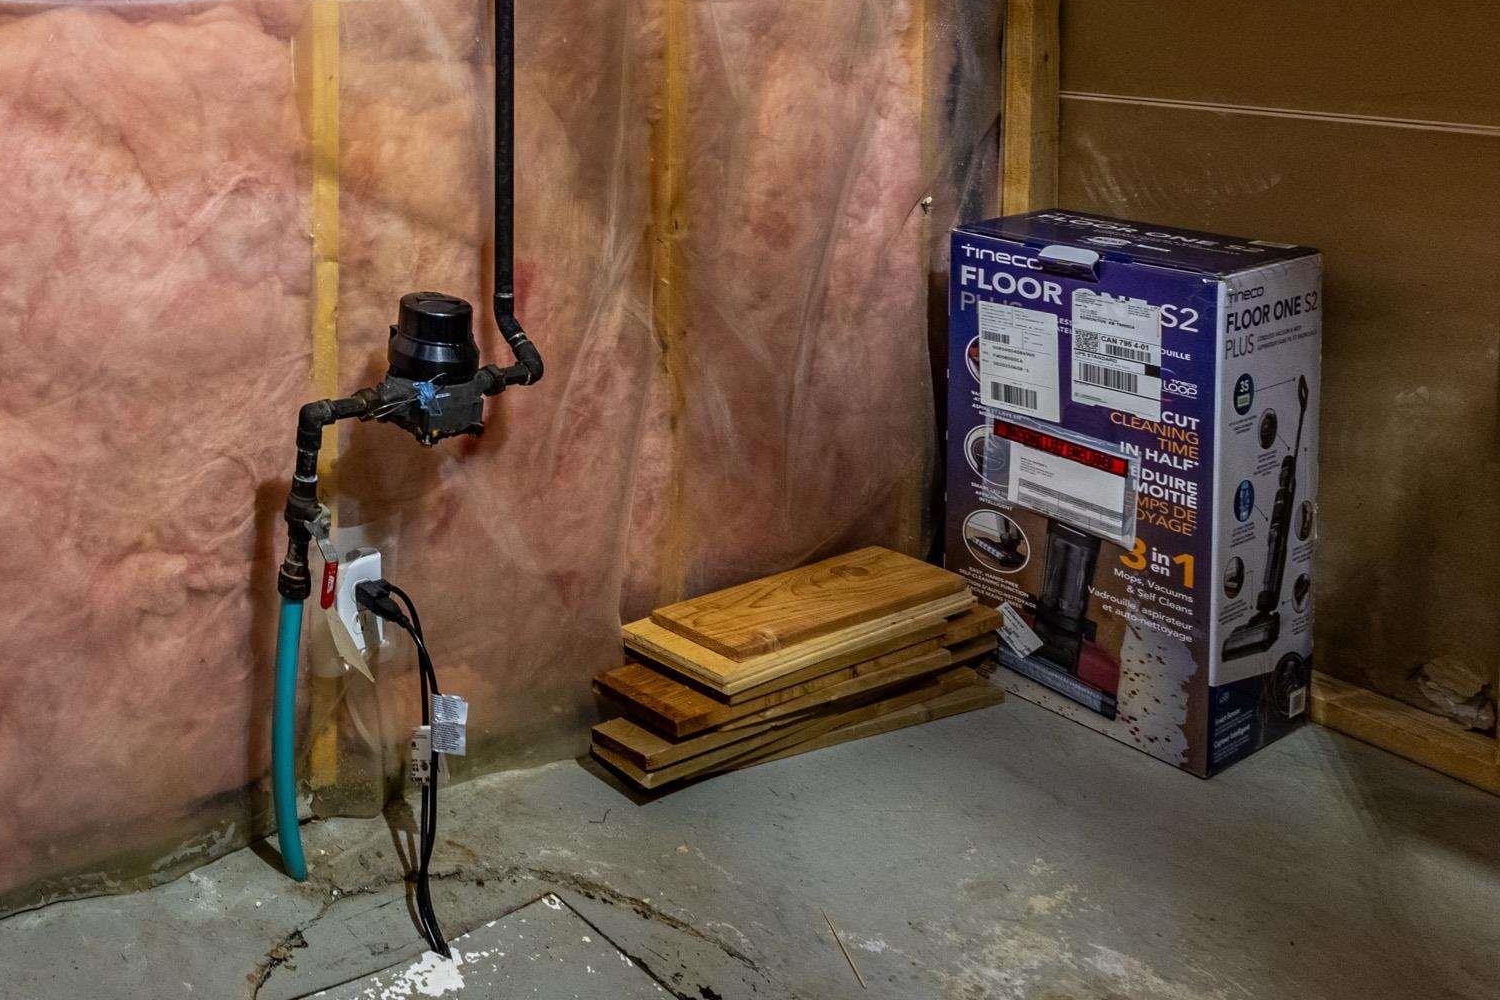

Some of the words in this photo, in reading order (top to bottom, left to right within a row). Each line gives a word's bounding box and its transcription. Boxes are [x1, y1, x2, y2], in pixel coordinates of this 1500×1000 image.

[961, 243, 1044, 271] tineco
[961, 264, 1063, 306] FLOOR
[1160, 304, 1199, 333] S2
[1226, 286, 1265, 304] tineco
[1226, 304, 1270, 334] FLOOR
[1274, 295, 1302, 321] ONE
[1304, 290, 1318, 313] S2
[1101, 335, 1118, 344] CAN
[1226, 334, 1254, 360] PLUS
[1161, 348, 1191, 361] OUILLE
[1163, 380, 1198, 396] LOOP
[1110, 412, 1199, 445] CLEANING
[1162, 411, 1200, 430] CUT
[1120, 441, 1138, 456] IN
[1157, 437, 1199, 460] TIME
[1173, 506, 1197, 523] DE
[1120, 537, 1146, 570] 3
[1151, 547, 1170, 567] in
[1172, 554, 1194, 588] 1
[1150, 563, 1170, 577] en
[1114, 568, 1145, 586] Mops,
[1147, 580, 1194, 604] Vacuums
[1126, 585, 1135, 594] &
[1138, 589, 1156, 602] Self
[1158, 596, 1194, 616] Cleans
[1102, 604, 1113, 612] et
[1114, 608, 1193, 643] auto-nettoyage
[1141, 608, 1194, 631] aspirateur
